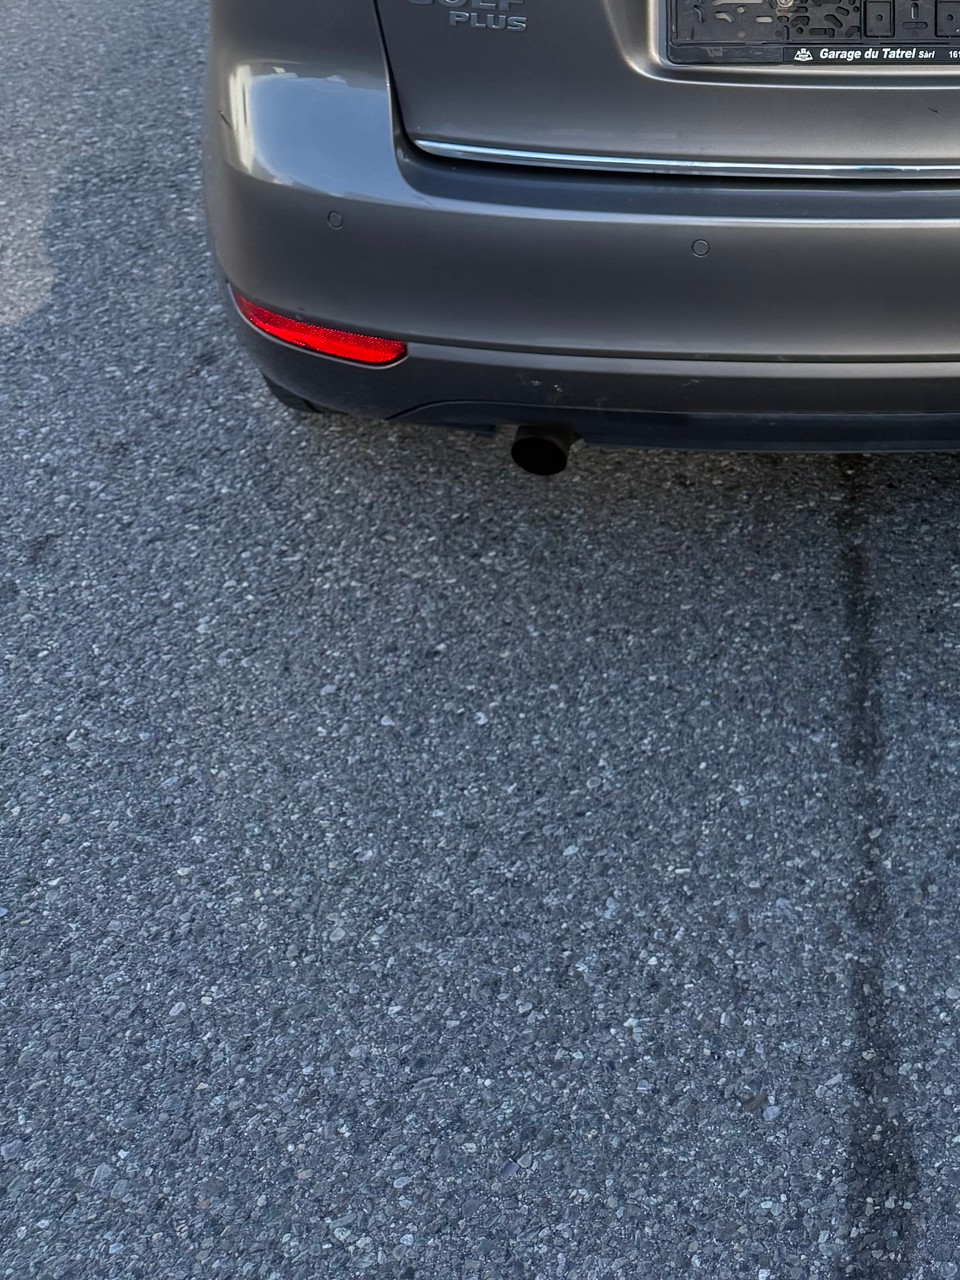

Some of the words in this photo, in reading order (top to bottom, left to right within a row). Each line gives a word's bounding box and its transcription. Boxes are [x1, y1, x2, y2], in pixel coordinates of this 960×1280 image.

[450, 10, 528, 32] PLUS
[819, 47, 862, 62] Garage
[864, 48, 879, 59] du
[882, 47, 917, 59] Tatrel
